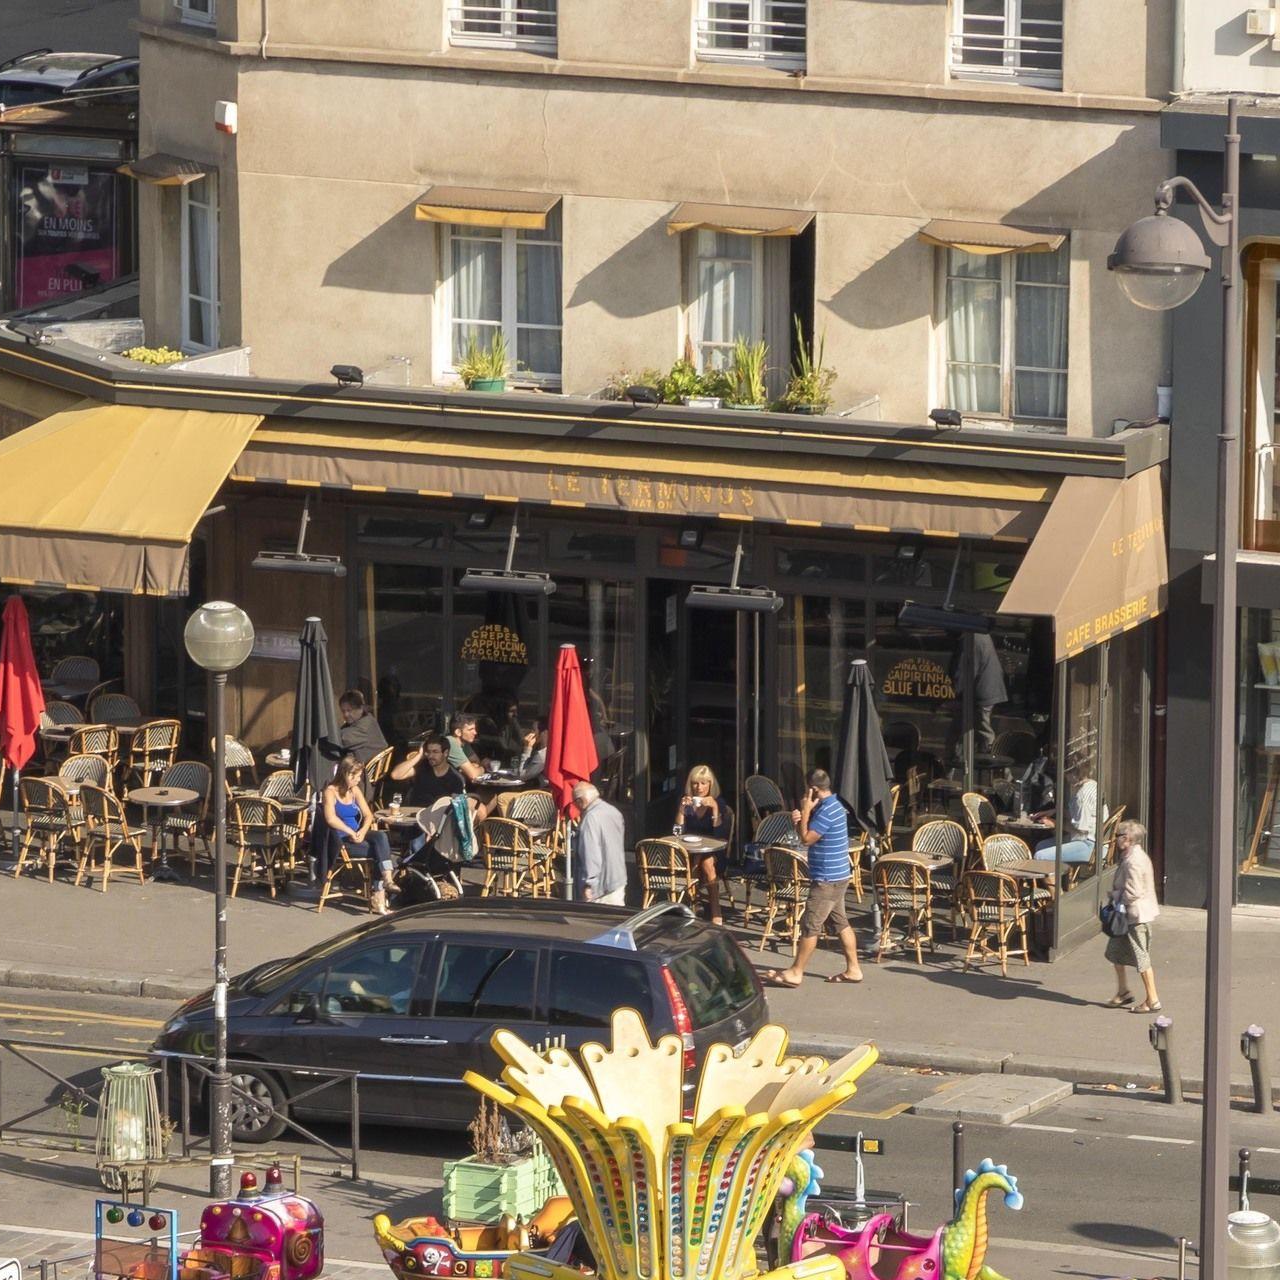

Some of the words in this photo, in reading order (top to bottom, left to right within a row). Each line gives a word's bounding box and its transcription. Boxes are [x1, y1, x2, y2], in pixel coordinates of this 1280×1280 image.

[547, 469, 580, 493] LE
[599, 472, 753, 508] TERMINUS
[1065, 621, 1091, 648] CAFE
[1095, 595, 1148, 635] BRASSERIE
[464, 637, 527, 653] CAPPUCCINO
[888, 670, 953, 685] CAIPIRINHA
[882, 680, 913, 696] BLUE
[917, 682, 956, 699] LAGON
